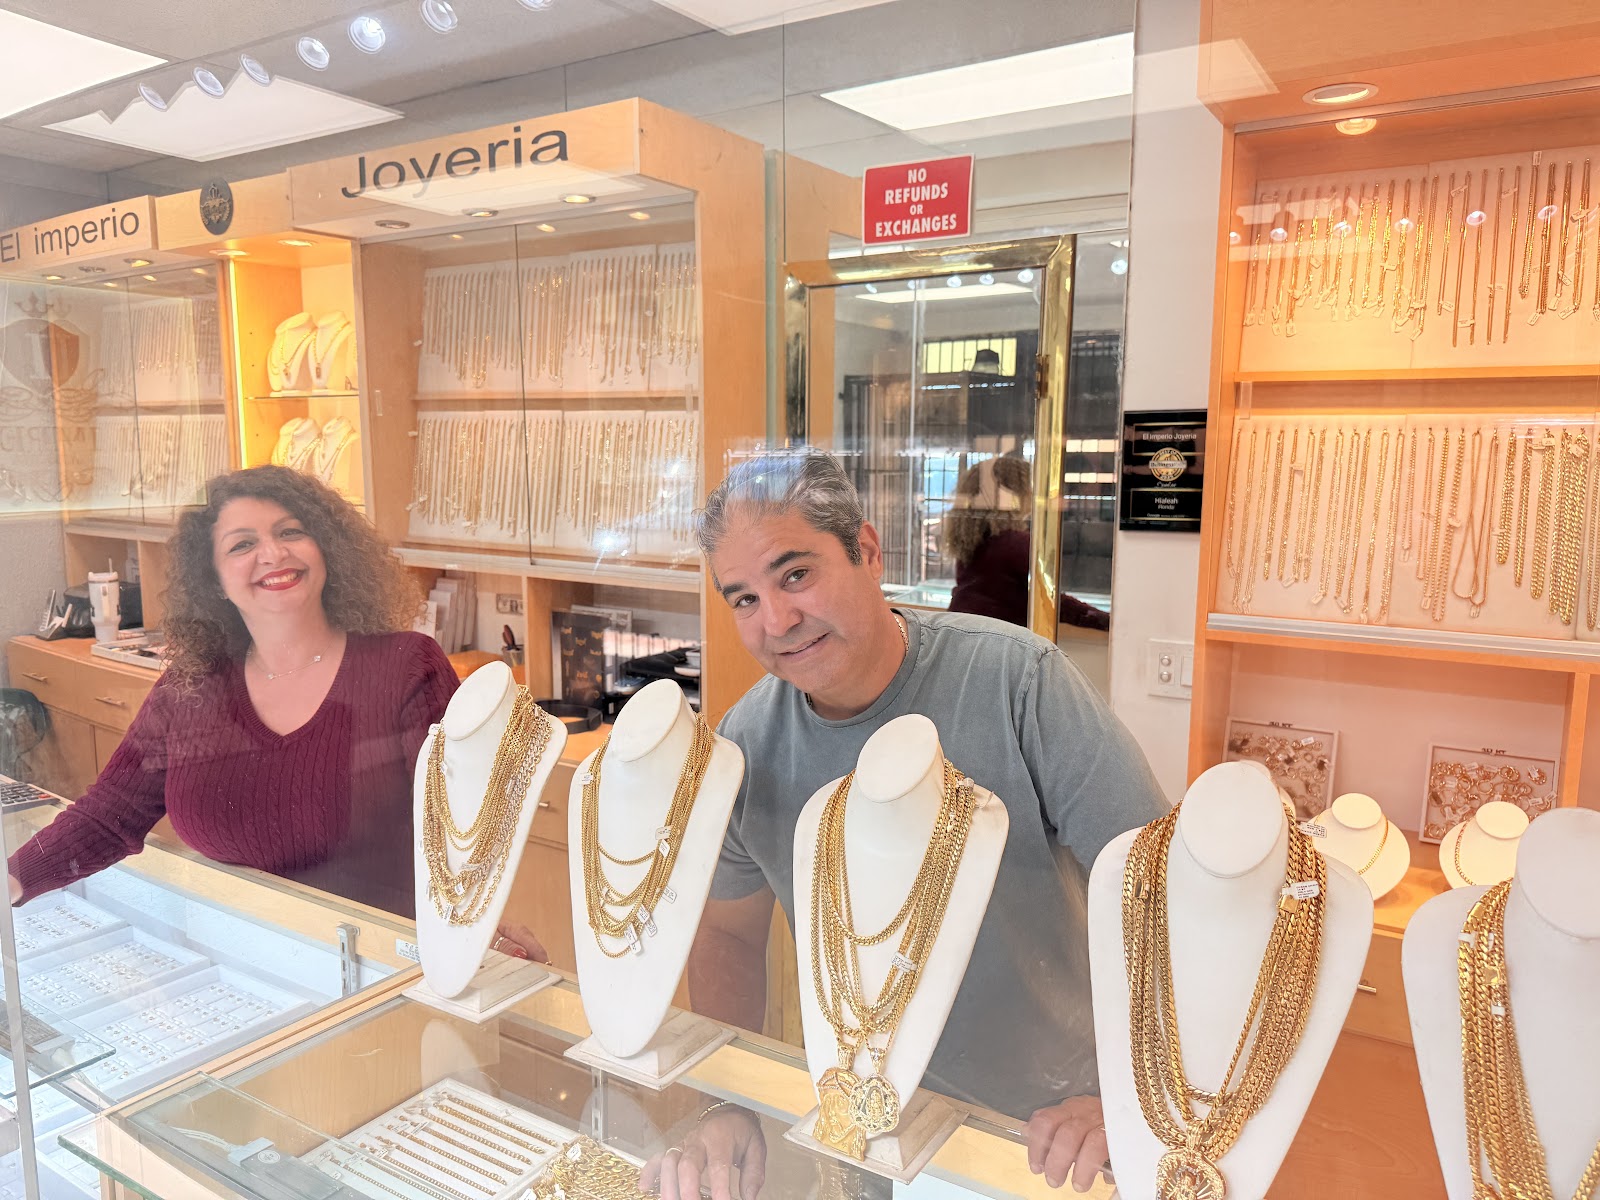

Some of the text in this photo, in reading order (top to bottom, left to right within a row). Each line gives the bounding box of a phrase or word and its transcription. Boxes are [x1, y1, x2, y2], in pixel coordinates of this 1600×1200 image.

[341, 125, 569, 199] Joyeria
[907, 168, 927, 184] NO
[884, 182, 949, 205] REFUNDS
[909, 204, 923, 215] OR
[0, 207, 140, 263] El imperio
[875, 213, 957, 238] EXCHANGES
[1174, 433, 1197, 441] Joyeria
